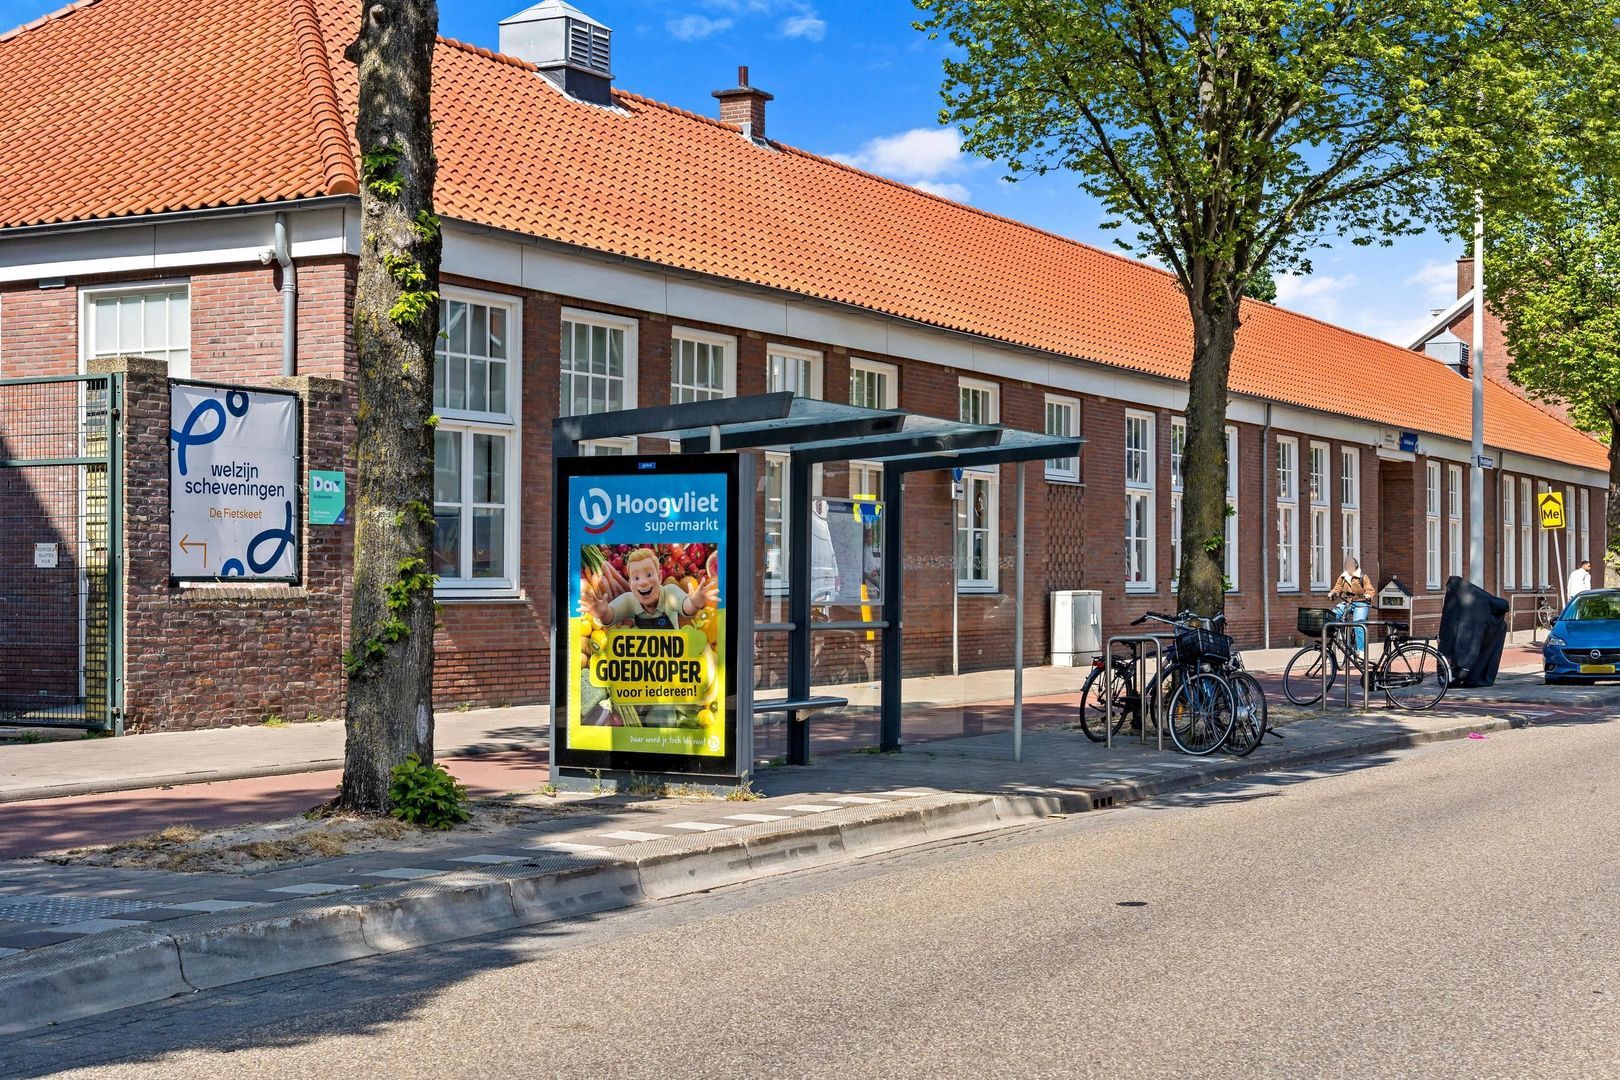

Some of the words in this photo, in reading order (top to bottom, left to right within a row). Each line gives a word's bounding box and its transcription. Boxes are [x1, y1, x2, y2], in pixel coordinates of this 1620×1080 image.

[211, 461, 259, 482] welzijn
[185, 477, 285, 500] scheveningen
[209, 507, 222, 518] De
[223, 508, 262, 519] Fietskeet
[616, 491, 719, 518] Hoogvliet
[1543, 509, 1560, 519] Me
[644, 517, 719, 534] supermarkt
[612, 635, 684, 658] GEZOND
[596, 659, 702, 683] GOEDKOPER
[616, 688, 642, 698] voor
[645, 685, 697, 697] iedereen!
